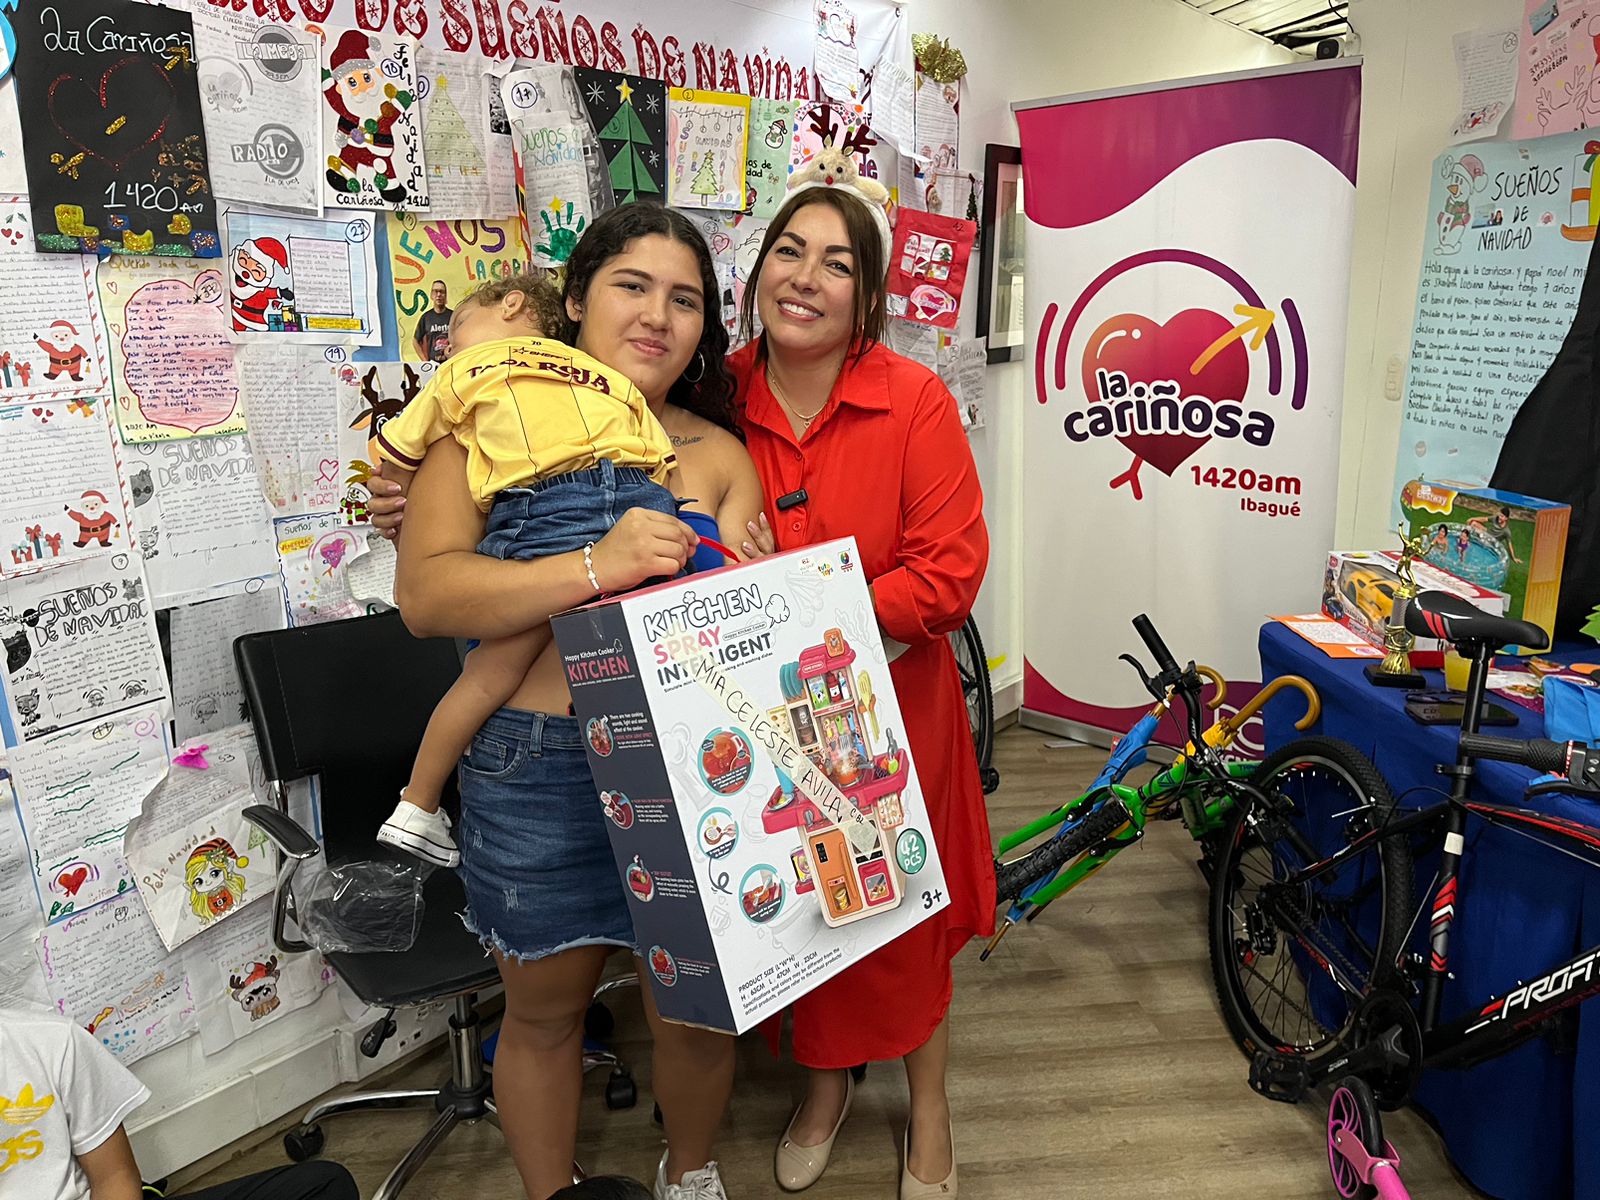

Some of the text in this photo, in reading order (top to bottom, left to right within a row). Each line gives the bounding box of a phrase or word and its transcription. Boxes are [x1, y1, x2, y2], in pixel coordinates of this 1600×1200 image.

[1491, 164, 1563, 202] SUEÑOS
[103, 182, 178, 212] 1420
[1512, 205, 1529, 224] DE
[1477, 226, 1533, 252] NAVIDAD
[1552, 283, 1576, 296] años
[327, 347, 342, 360] 19
[537, 361, 611, 395] ROJA
[1063, 371, 1275, 446] la cariñosa
[1191, 465, 1301, 495] 1420am
[1240, 498, 1301, 517] Ibagué
[643, 583, 763, 643] KITCHEN
[580, 650, 598, 659] Kitchen
[653, 625, 721, 666] SPRAY
[567, 655, 631, 682] KITCHEN
[695, 658, 726, 697] MIA
[726, 690, 799, 769] CELESTE
[801, 768, 844, 824] AVILA
[900, 834, 920, 856] 42
[921, 888, 943, 910] 3+
[738, 973, 763, 993] PRODUCT
[763, 967, 775, 978] SIZE
